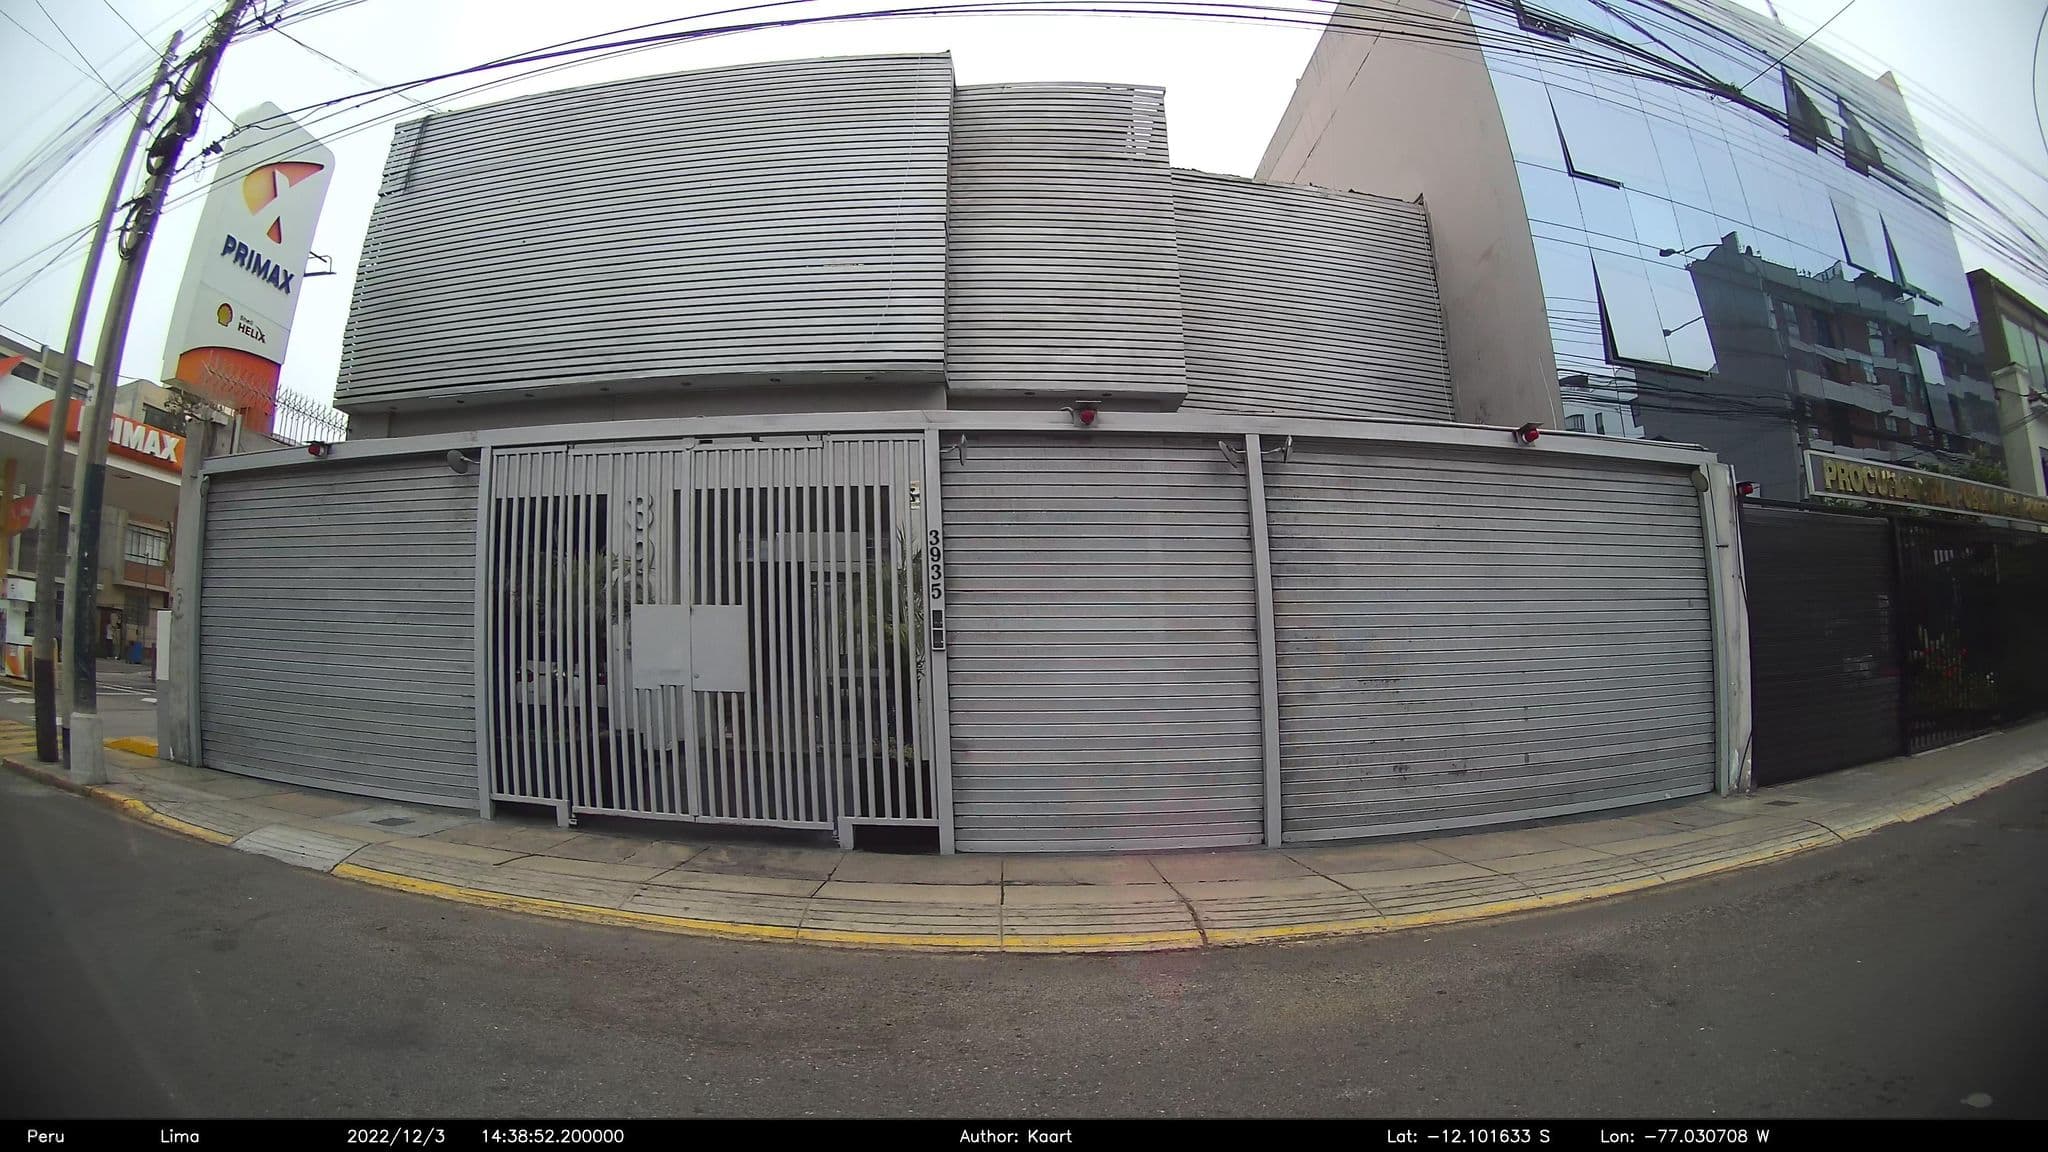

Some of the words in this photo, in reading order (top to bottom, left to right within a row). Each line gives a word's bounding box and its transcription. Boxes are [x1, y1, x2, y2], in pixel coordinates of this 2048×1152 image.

[221, 233, 295, 295] PRIMAX
[237, 322, 266, 344] HELIX
[929, 529, 942, 600] 3935
